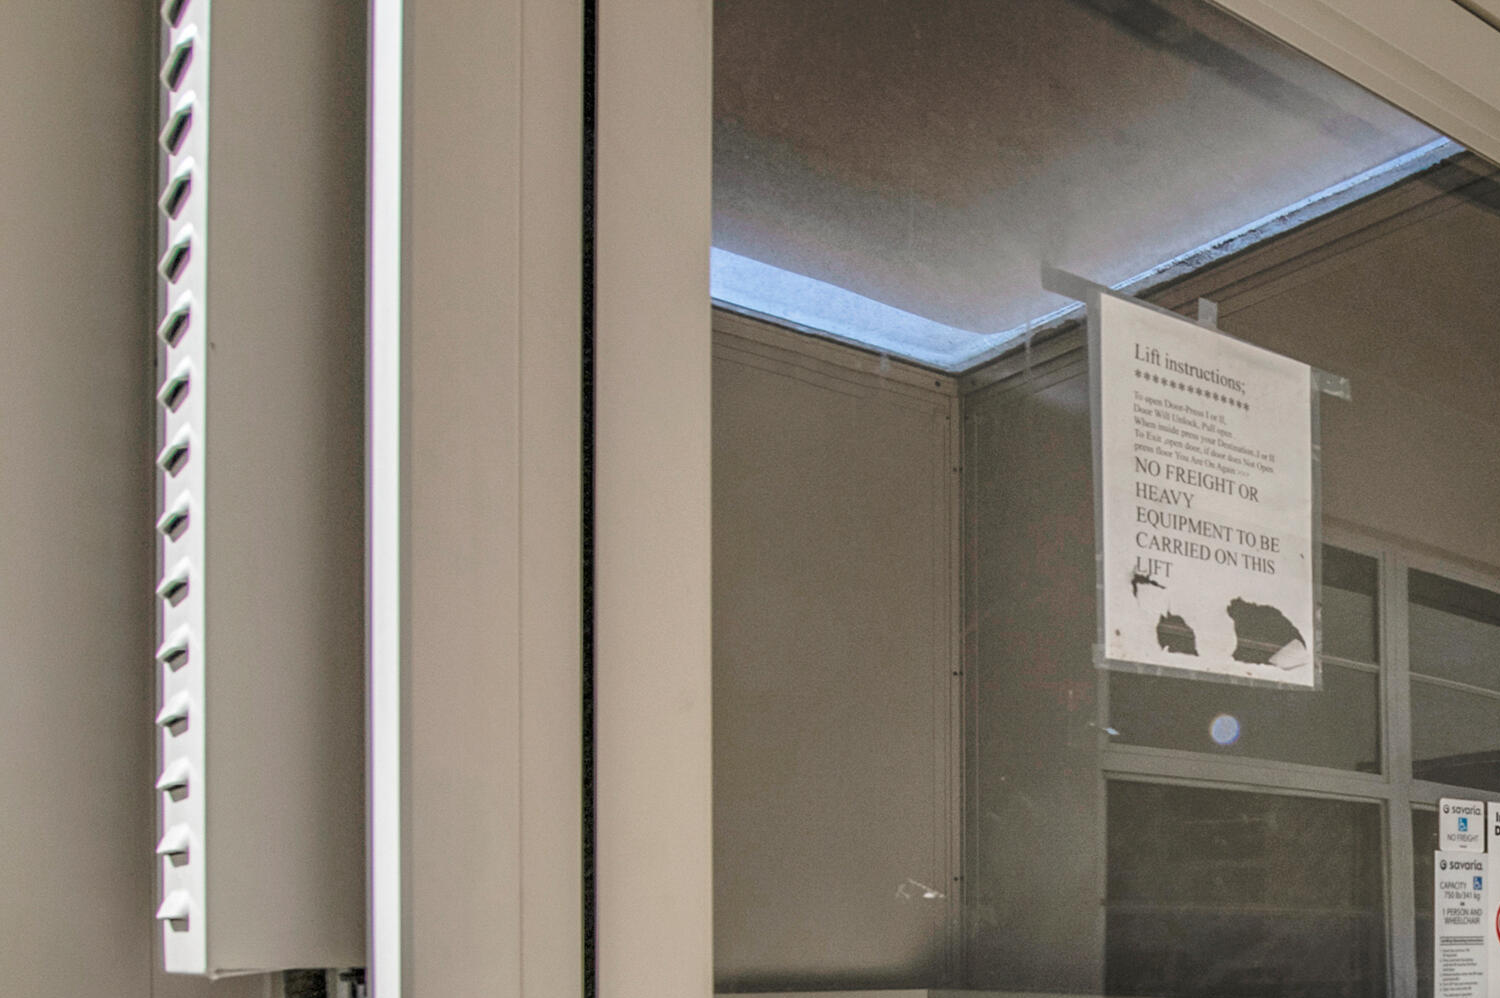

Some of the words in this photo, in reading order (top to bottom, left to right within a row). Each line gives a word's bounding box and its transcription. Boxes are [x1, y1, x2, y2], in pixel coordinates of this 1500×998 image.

[1134, 343, 1160, 366] Lift
[1165, 353, 1246, 396] instructions;
[1134, 415, 1156, 429] When
[1202, 422, 1216, 433] Pull
[1135, 456, 1160, 476] NO
[1166, 464, 1236, 495] FREIGHT
[1239, 484, 1259, 502] OR
[1136, 482, 1194, 508] HEAVY
[1136, 506, 1233, 542] EQUIPMENT
[1236, 528, 1256, 548] TO
[1260, 535, 1280, 553] BE
[1136, 532, 1212, 560] CARRIED
[1214, 548, 1238, 567] ON
[1242, 554, 1276, 574] THIS
[1136, 556, 1174, 578] LIFT
[1456, 834, 1480, 842] FREIGHT
[1440, 881, 1467, 890] CAPACITY
[1444, 916, 1480, 925] WHEELCHAIR
[1447, 908, 1469, 916] PERSON
